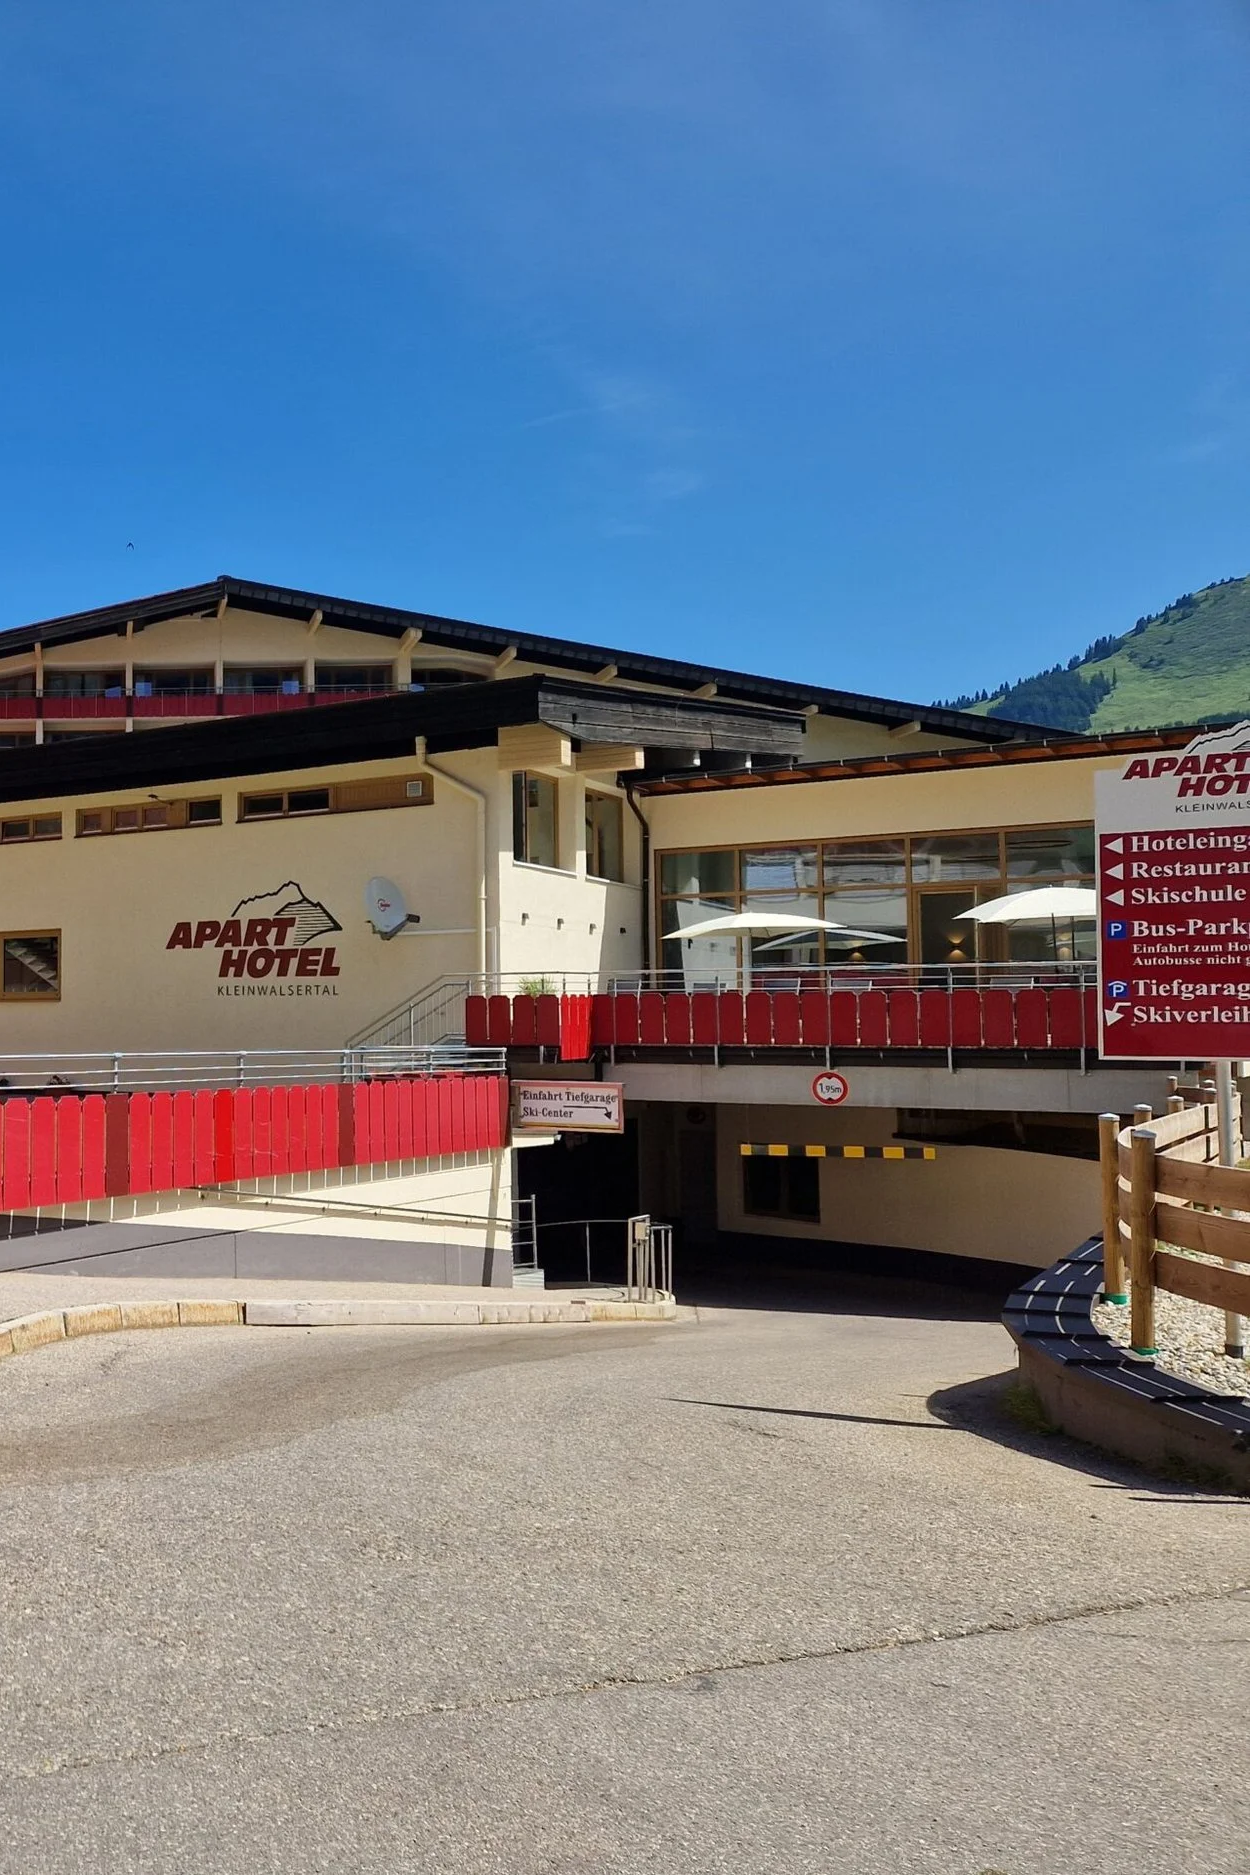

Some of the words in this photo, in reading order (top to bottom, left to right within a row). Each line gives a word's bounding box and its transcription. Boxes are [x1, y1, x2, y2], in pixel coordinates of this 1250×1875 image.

[1122, 752, 1250, 780] APART
[1130, 832, 1250, 853] Hoteleing
[1131, 885, 1247, 905] Skischule
[166, 917, 296, 949] APART
[1132, 943, 1189, 954] Einfahrt
[1193, 945, 1223, 953] zum
[218, 947, 341, 979] HOTEL
[1132, 955, 1203, 966] Autobusse
[1206, 954, 1241, 965] nicht
[217, 984, 339, 997] KLEINWALSERTAL
[522, 1090, 563, 1101] Einfahrt
[565, 1091, 616, 1104] Tiefgarage
[522, 1107, 574, 1118] Ski-Center
